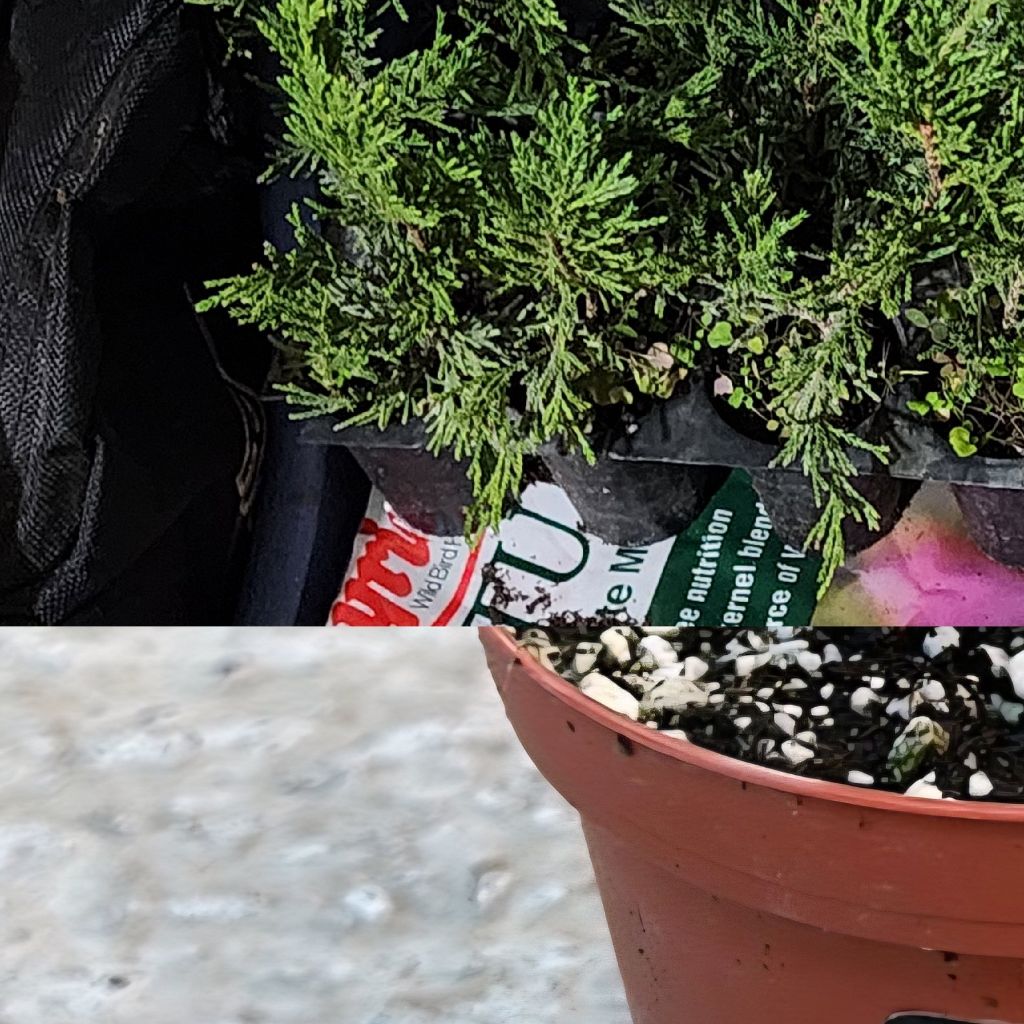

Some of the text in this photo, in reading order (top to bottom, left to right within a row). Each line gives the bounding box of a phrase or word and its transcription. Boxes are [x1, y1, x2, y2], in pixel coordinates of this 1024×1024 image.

[410, 579, 442, 610] Wild
[428, 547, 458, 581] Bird
[687, 508, 733, 603] nutrition
[776, 562, 801, 583] of
[721, 565, 757, 626] ernel
